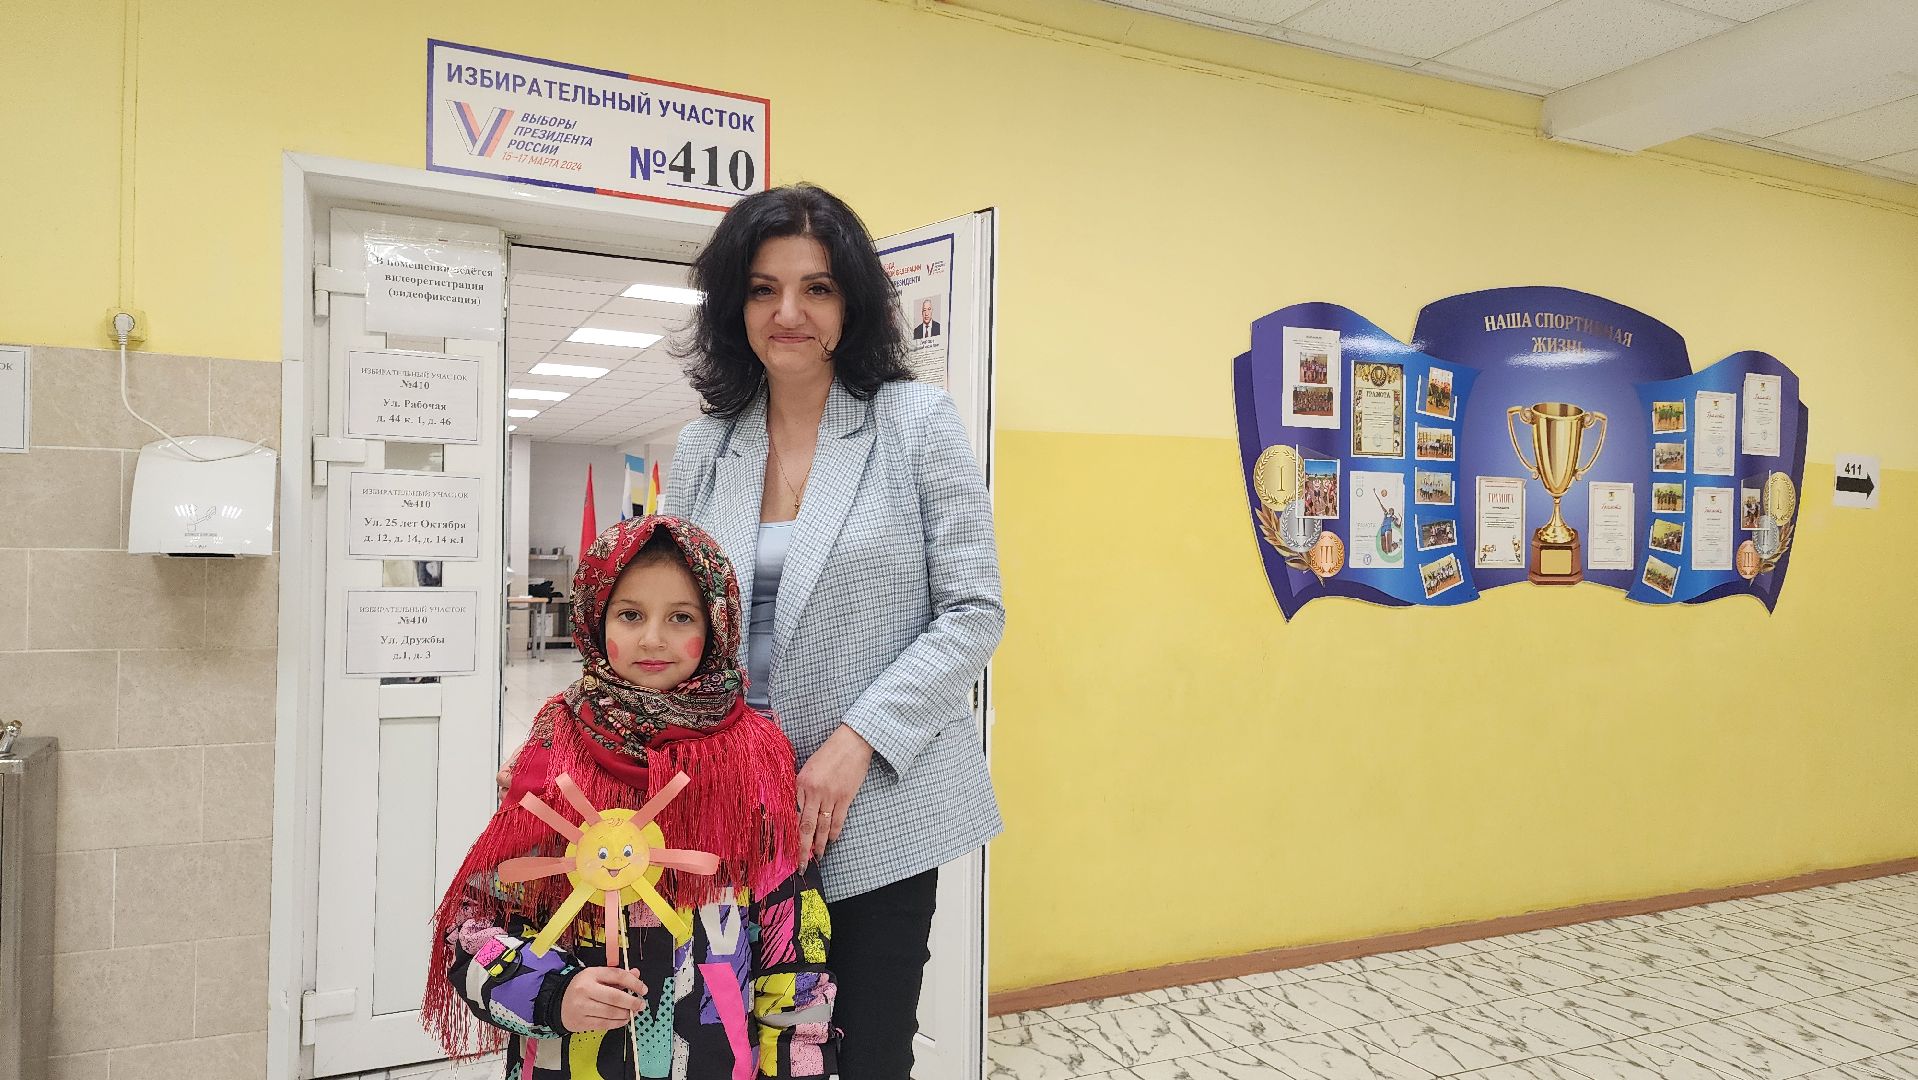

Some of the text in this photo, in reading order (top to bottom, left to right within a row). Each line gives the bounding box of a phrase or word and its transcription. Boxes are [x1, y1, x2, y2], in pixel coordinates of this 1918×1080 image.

[446, 63, 755, 133] ИЗБИРАТЕЛЬНЫЙ УЧАСТОК
[521, 112, 577, 129] ВЫБОРЫ
[514, 126, 593, 147] ПРЕЗИДЕНТА
[507, 139, 559, 155] РОССИИ
[528, 155, 559, 168] МАРТА
[560, 161, 583, 171] 2024
[385, 274, 484, 291] видеорегистрация
[1484, 312, 1532, 332] НАША
[383, 398, 446, 410] Ул. Рабочая
[389, 414, 400, 423] 44
[440, 417, 452, 426] 46
[1844, 462, 1862, 475] 411
[364, 517, 466, 530] Ул. 25 лет Октября
[437, 535, 447, 543] 14
[360, 605, 427, 613] ИЗБИРАТЕЛЬНЫЙ
[398, 616, 428, 625] №410
[380, 635, 445, 646] Ул. Дружбы
[425, 650, 431, 660] 3
